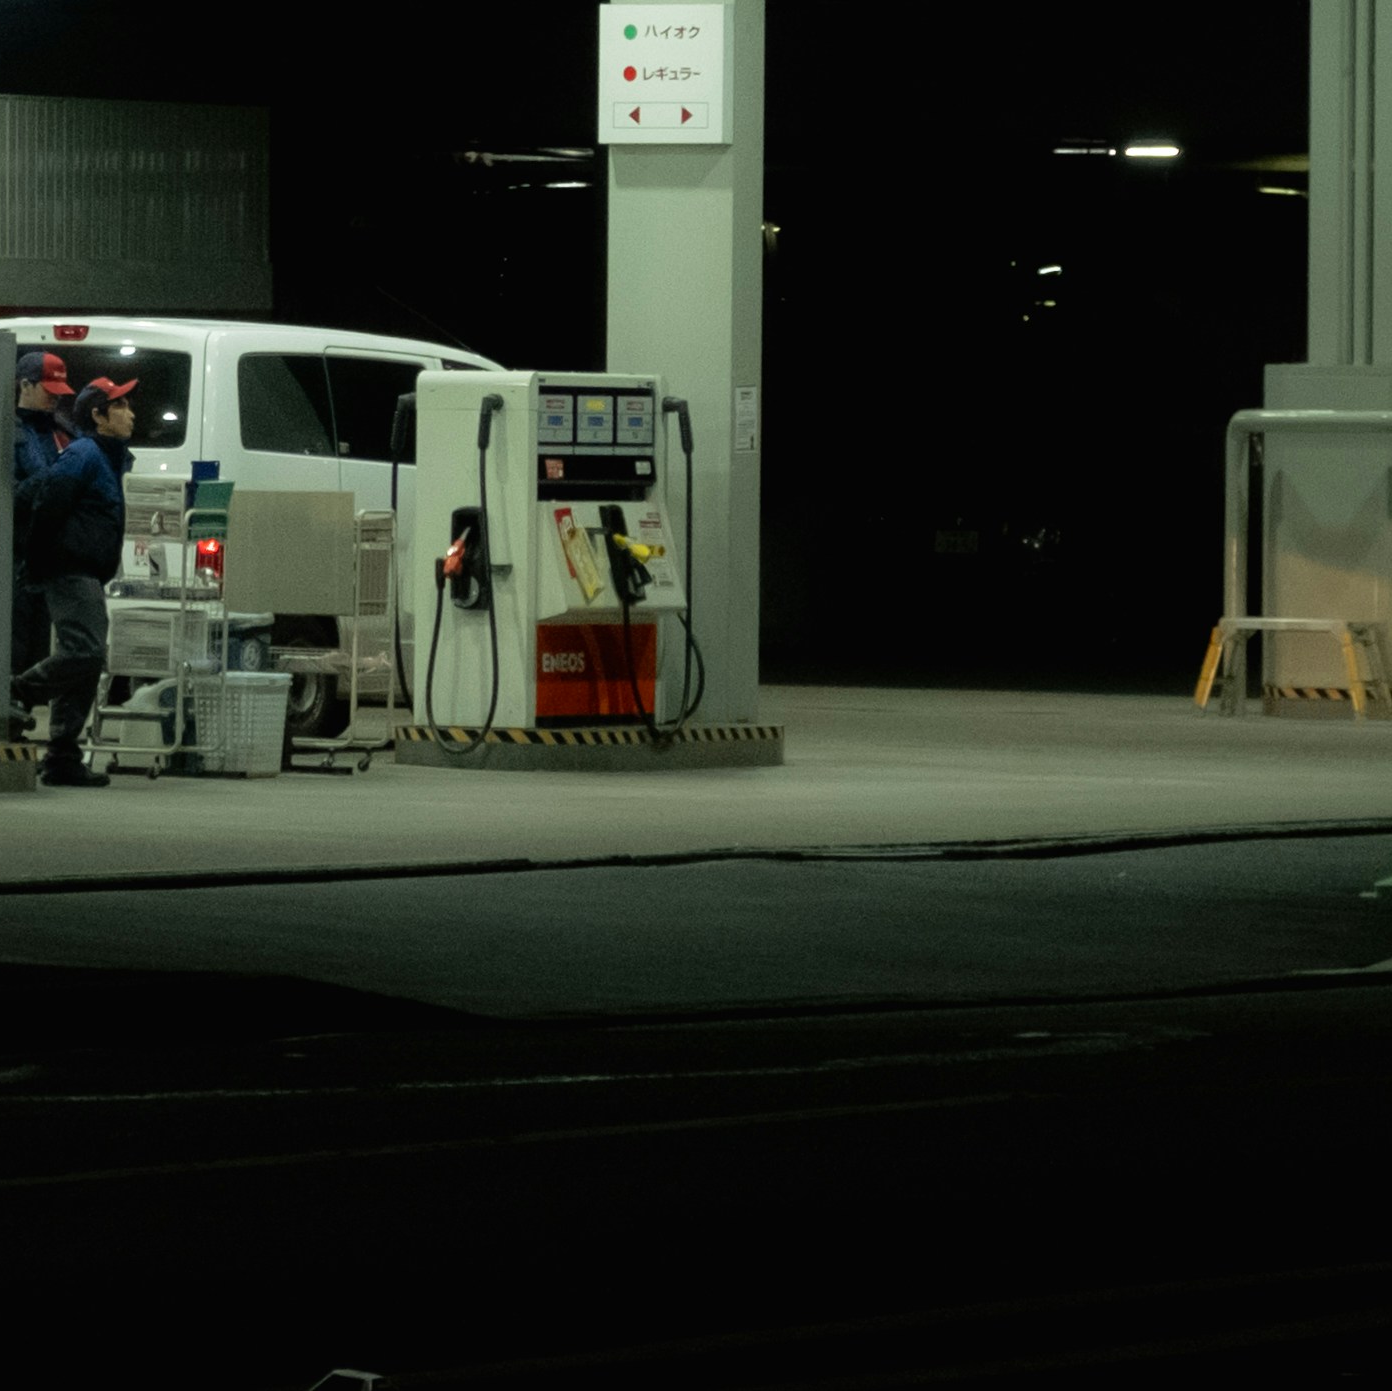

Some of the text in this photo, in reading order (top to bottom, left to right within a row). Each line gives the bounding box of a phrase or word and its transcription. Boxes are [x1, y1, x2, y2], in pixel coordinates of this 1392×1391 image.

[644, 25, 701, 39] ハイオク
[642, 67, 701, 81] レギュラー
[541, 651, 586, 674] ENEOS
